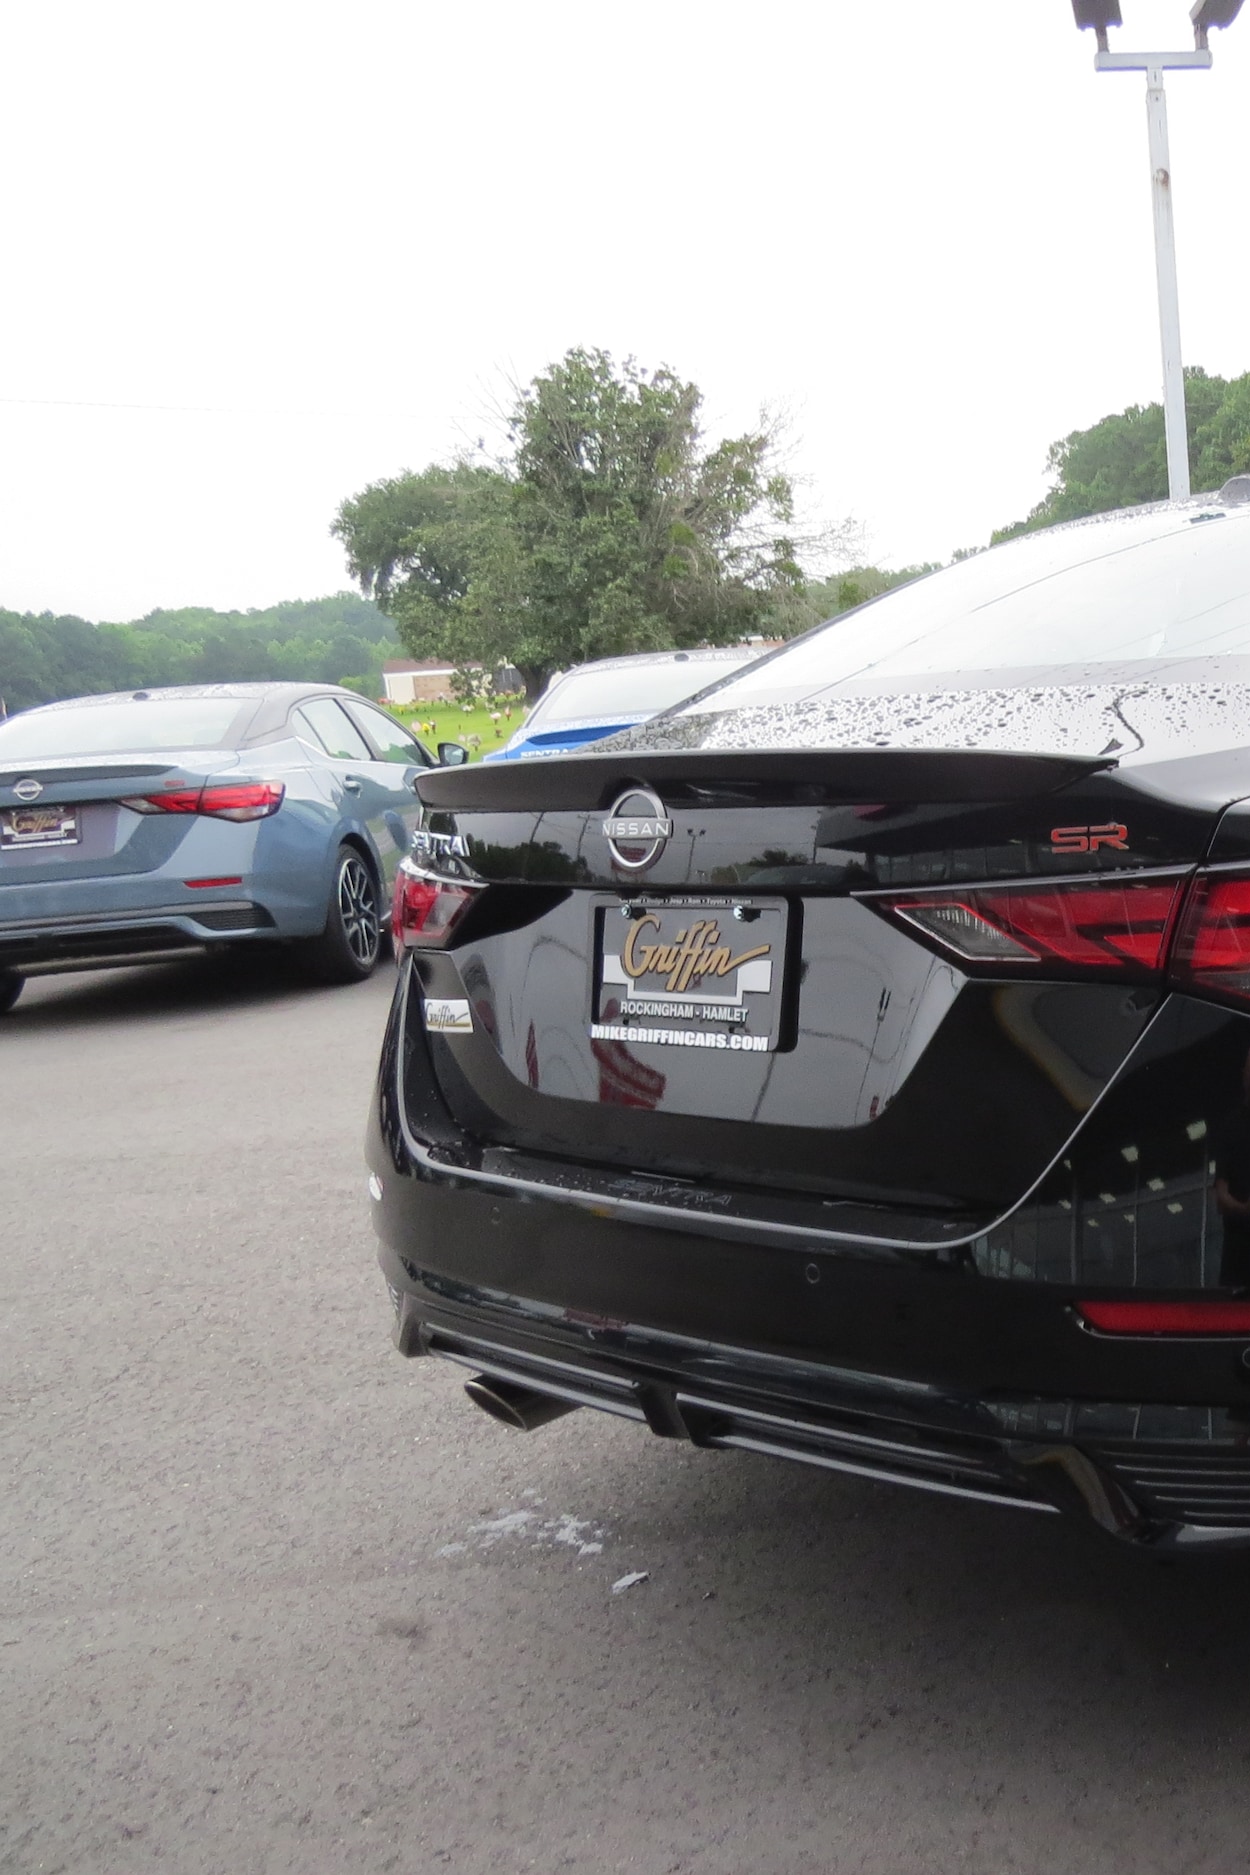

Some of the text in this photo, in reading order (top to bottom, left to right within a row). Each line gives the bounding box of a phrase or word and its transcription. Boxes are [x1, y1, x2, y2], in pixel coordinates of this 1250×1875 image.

[602, 822, 669, 836] NISSAN
[1050, 824, 1130, 854] SR
[624, 913, 771, 993] Griffin
[426, 1002, 469, 1030] Griffin
[620, 1000, 749, 1023] ROCKINGHAM HAMLET
[590, 1023, 769, 1052] MIKEGRIFFINCARS.COM
